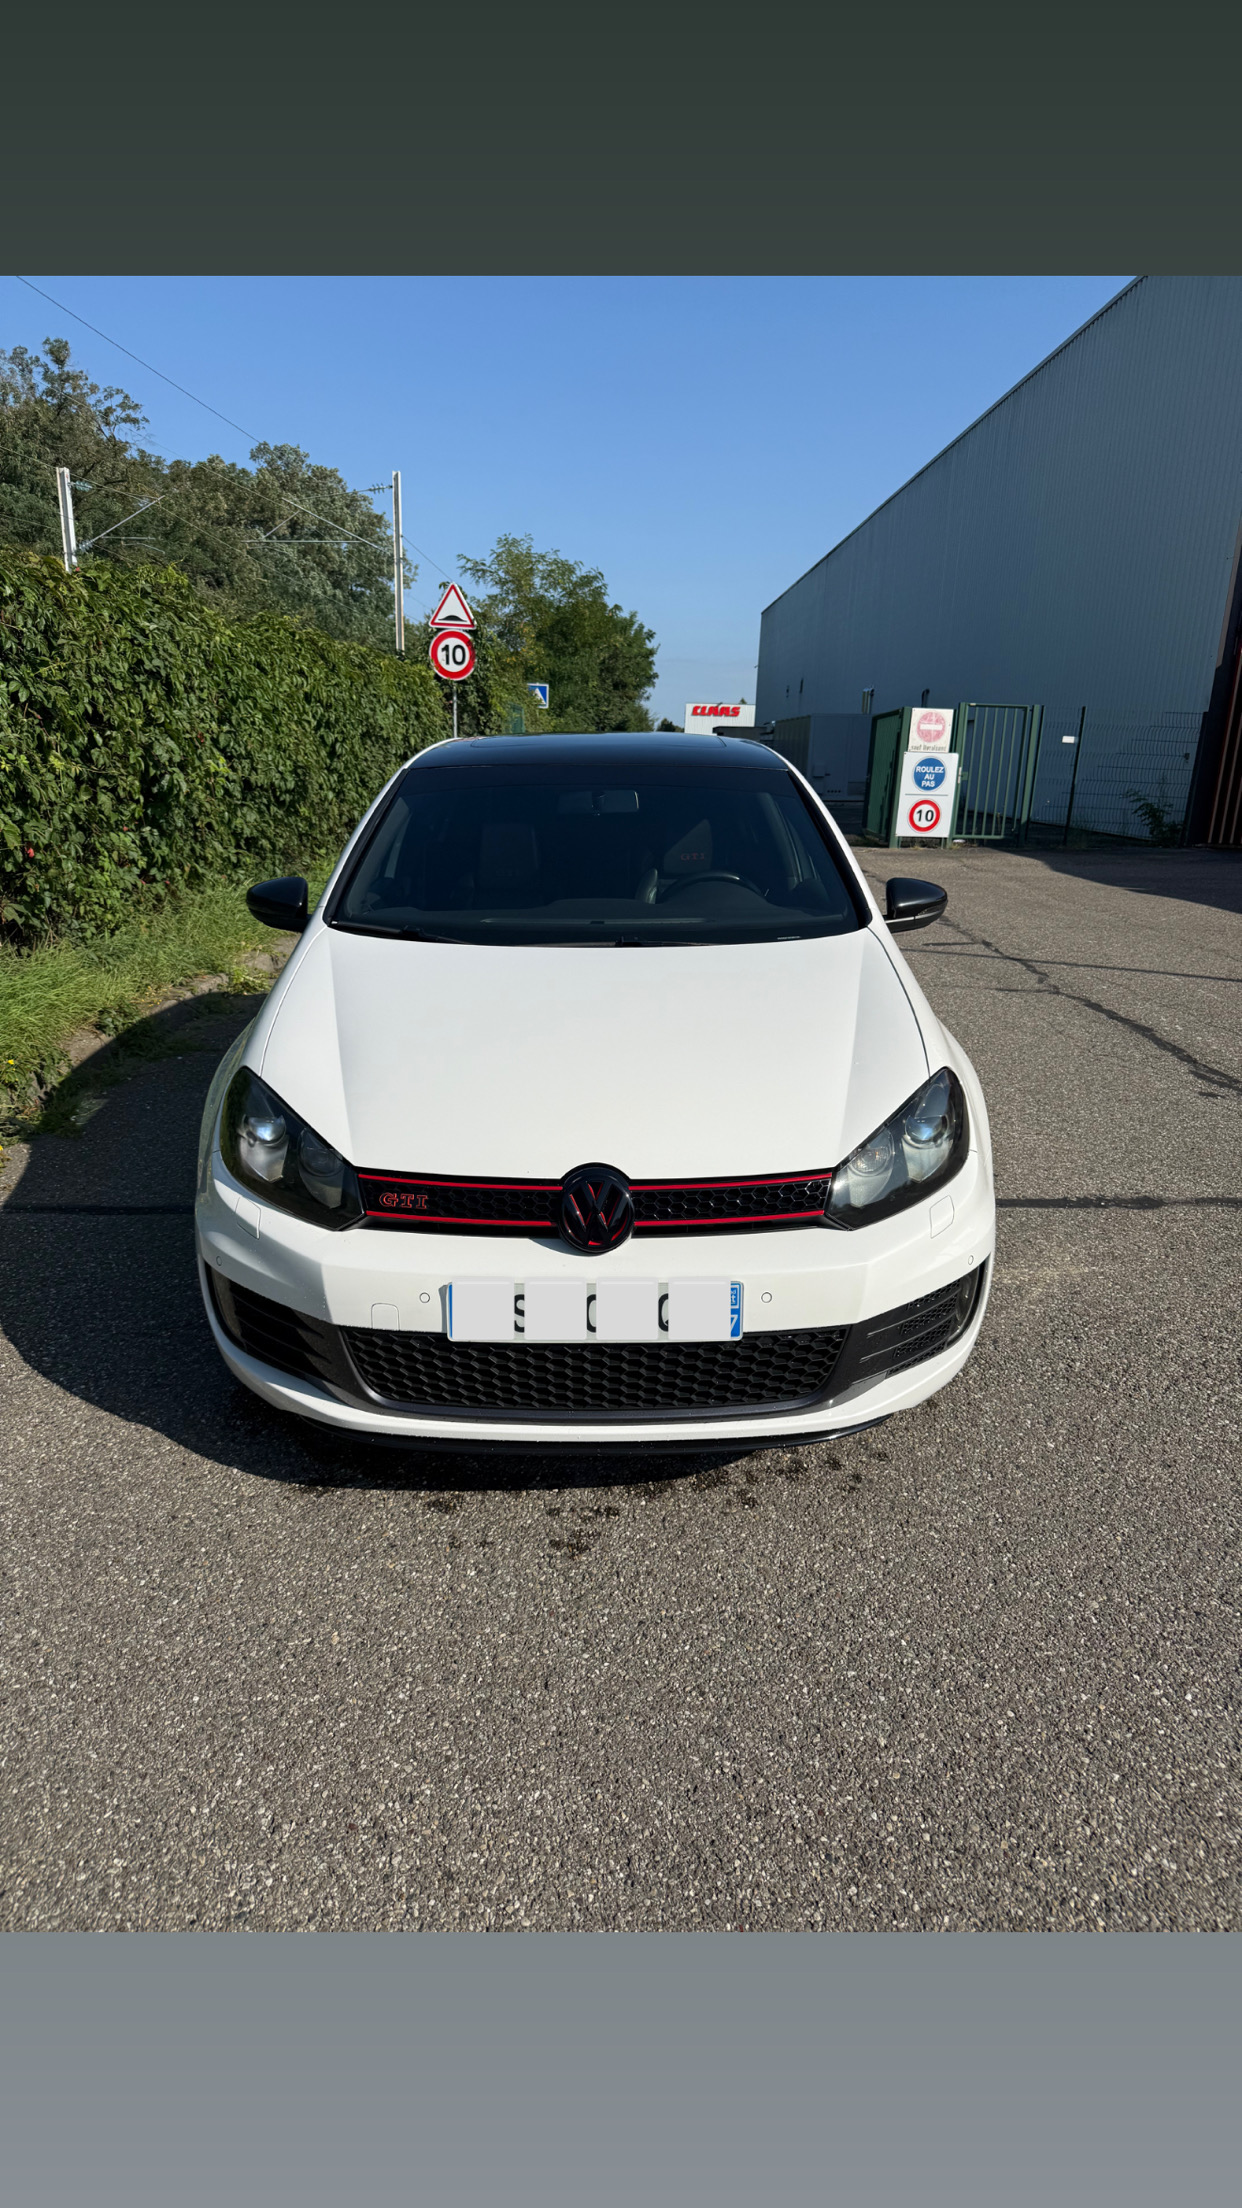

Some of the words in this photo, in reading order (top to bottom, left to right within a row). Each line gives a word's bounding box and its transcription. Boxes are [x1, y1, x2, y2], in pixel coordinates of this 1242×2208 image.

[441, 644, 466, 665] 10
[691, 705, 741, 717] CLAAS
[916, 809, 935, 822] 10
[379, 1192, 428, 1210] GTI
